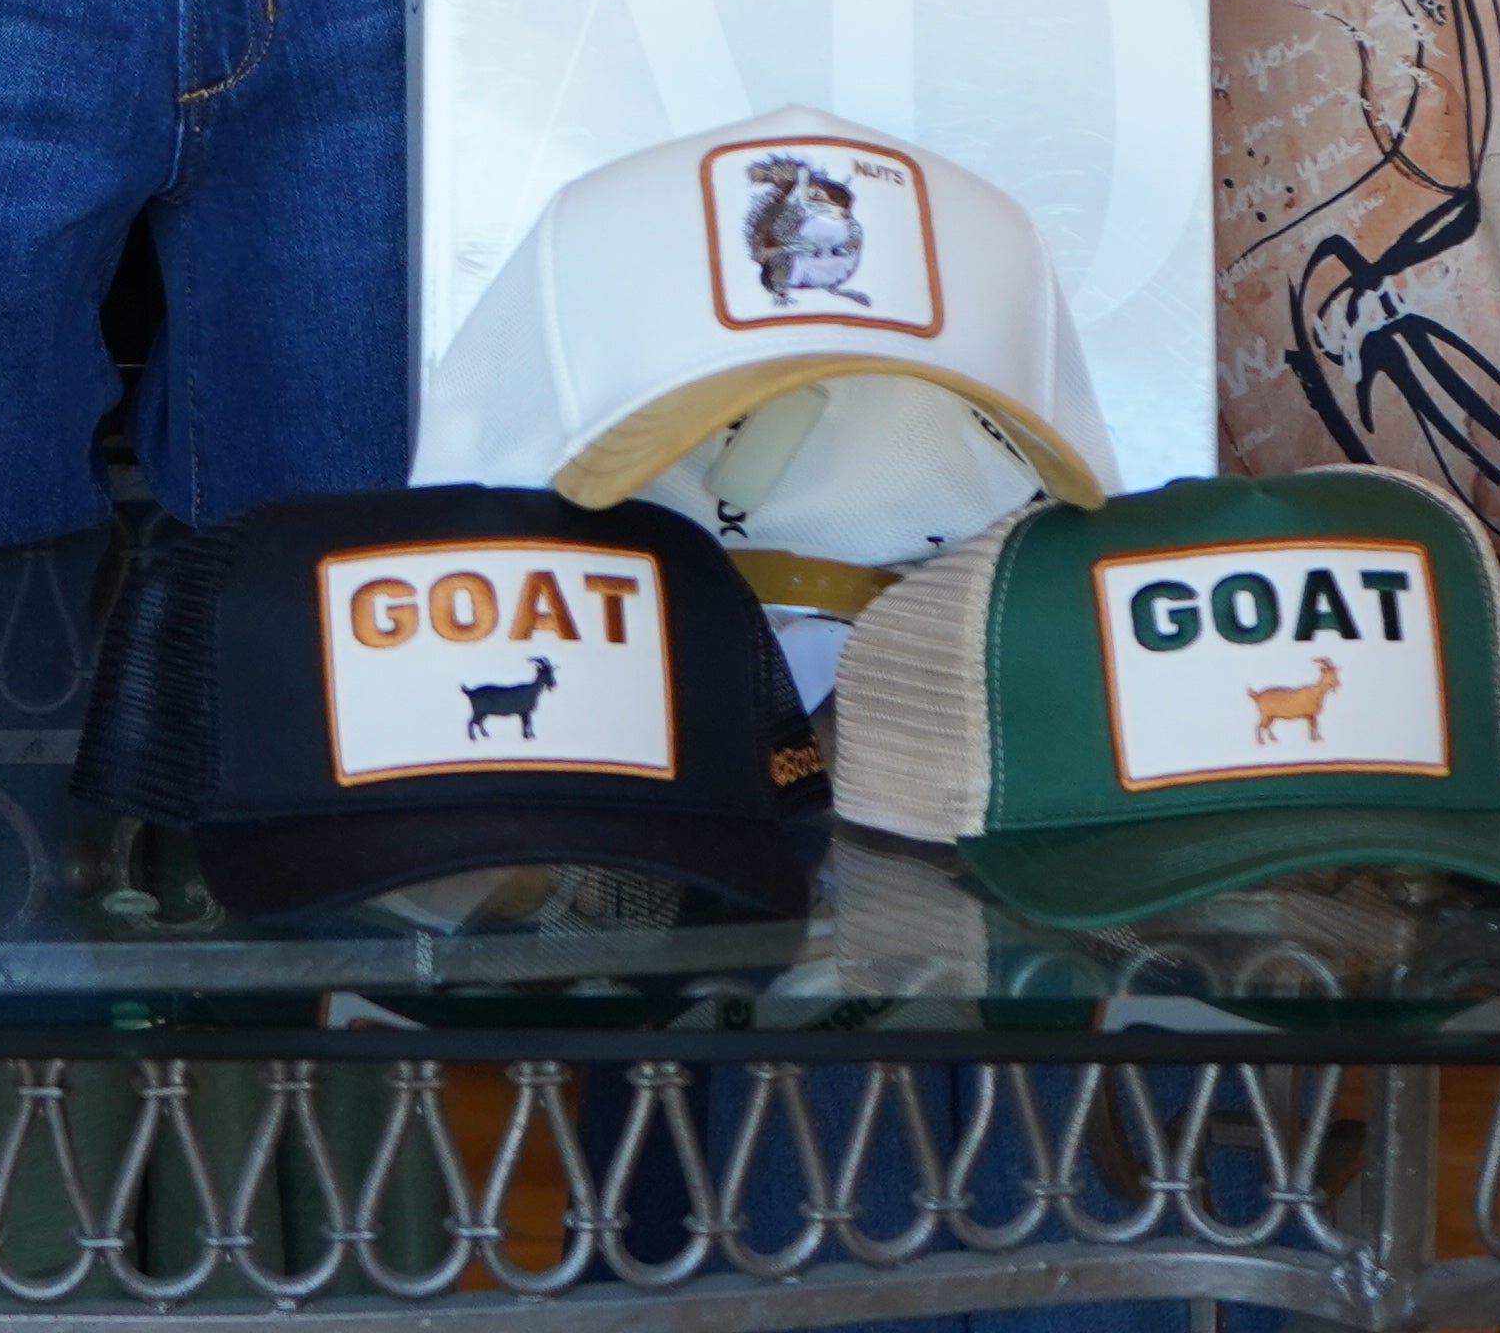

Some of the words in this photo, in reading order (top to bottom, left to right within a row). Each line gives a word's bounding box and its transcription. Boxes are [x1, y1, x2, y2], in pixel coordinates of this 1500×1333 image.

[852, 157, 907, 187] NUTS
[348, 569, 642, 651] GOAT
[1128, 568, 1411, 655] GOAT
